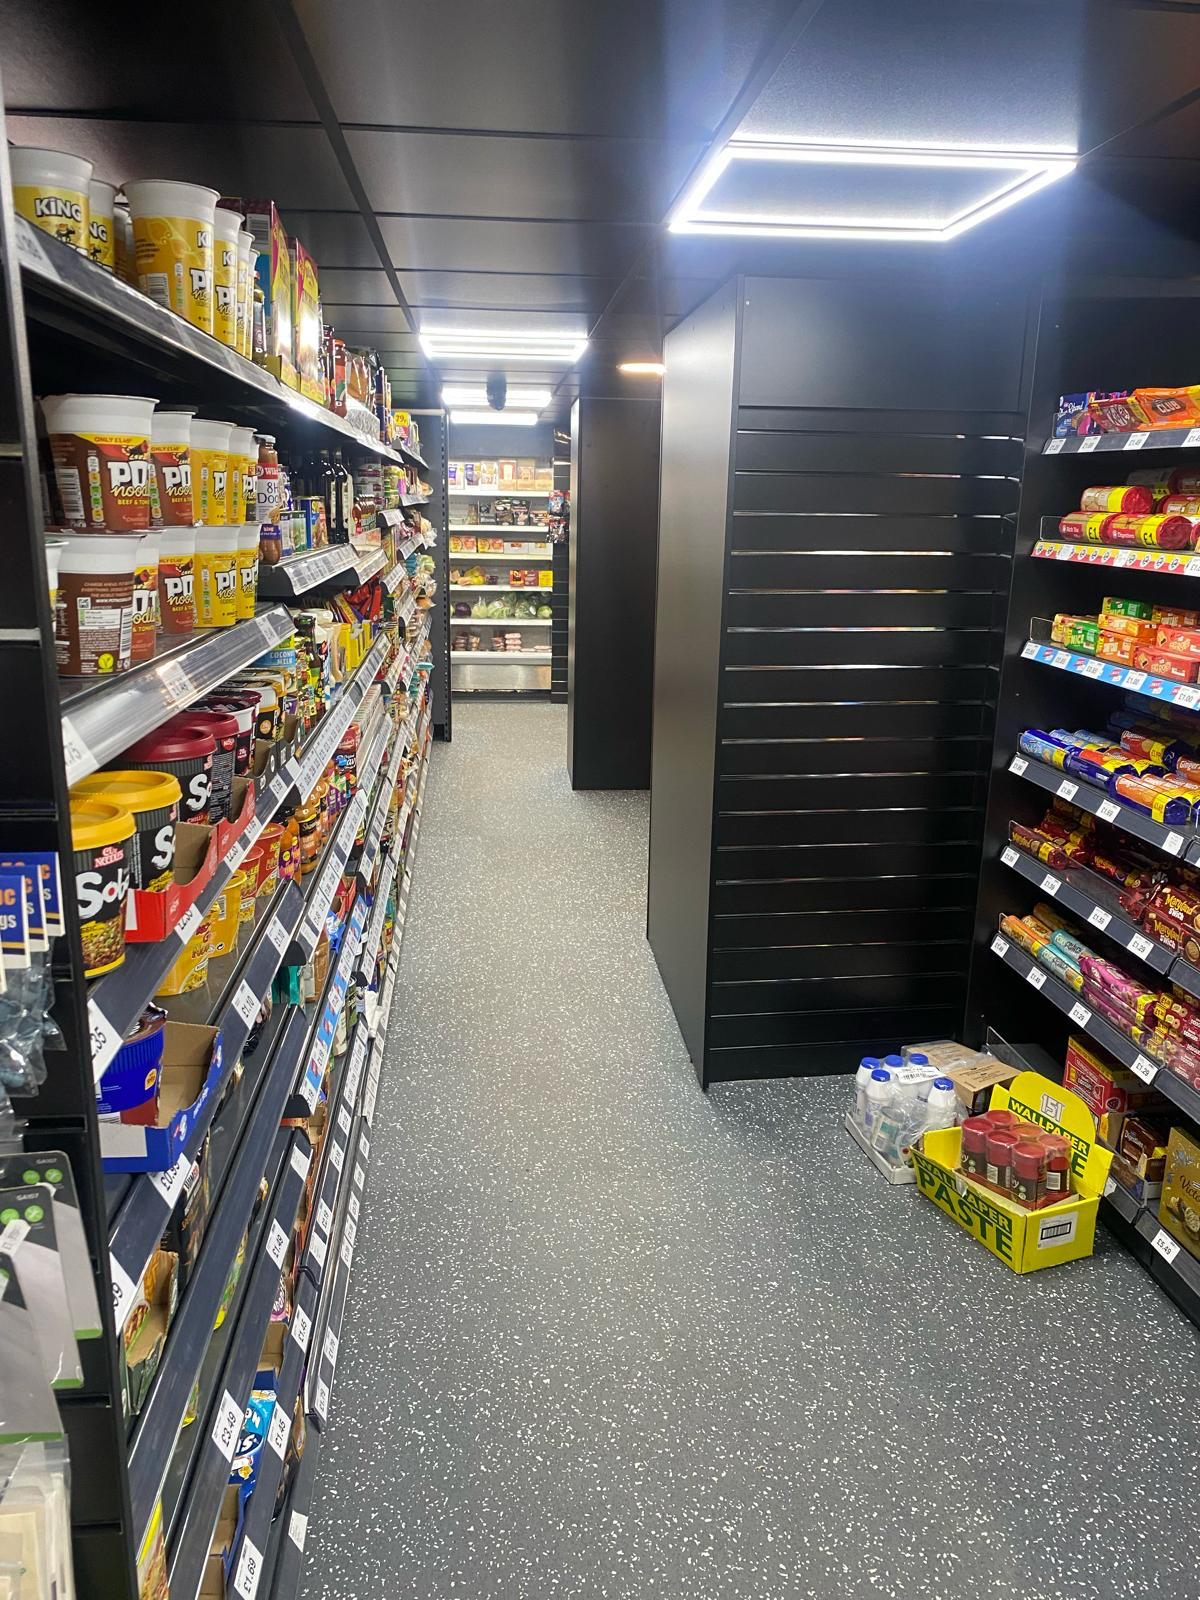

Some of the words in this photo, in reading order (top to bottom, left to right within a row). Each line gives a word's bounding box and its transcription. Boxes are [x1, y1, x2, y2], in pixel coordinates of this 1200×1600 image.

[1156, 400, 1181, 414] CLUB
[107, 460, 149, 488] PO
[162, 465, 192, 489] PO
[1088, 527, 1099, 540] £1
[1143, 532, 1156, 546] £1
[164, 574, 193, 600] PO
[132, 589, 157, 616] OT
[1070, 633, 1085, 645] NICE
[1178, 693, 1194, 703] £1.00
[1165, 893, 1196, 916] Maryland
[1154, 920, 1183, 942] Maryland
[1131, 941, 1146, 954] £1.29
[241, 994, 256, 1019] £1.10
[1072, 1008, 1085, 1021] £1.29
[1136, 1062, 1151, 1077] £1.29
[1040, 1093, 1065, 1122] 151
[1124, 1129, 1144, 1149] Digestives
[160, 1161, 180, 1191] £0.99
[917, 1165, 1013, 1262] PASTE
[1156, 1238, 1172, 1255] £5.49
[298, 1320, 307, 1342] £1.45
[221, 1411, 237, 1448] £3.49
[274, 1418, 287, 1449] £1.45
[244, 1556, 257, 1592] £1.69
